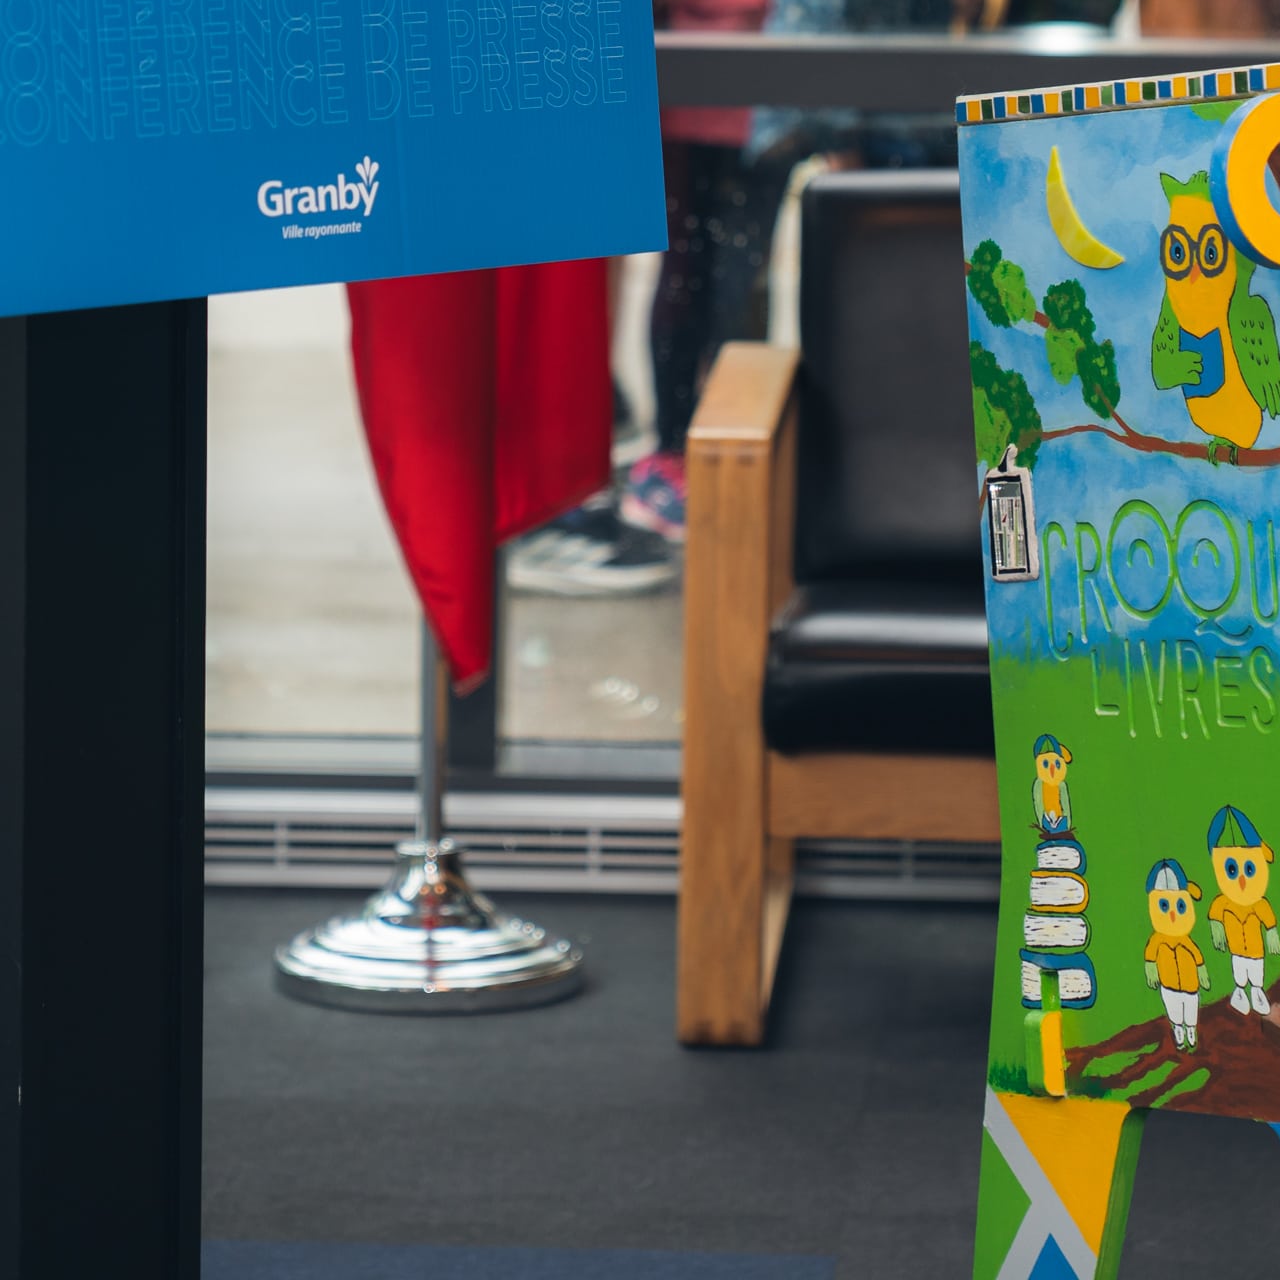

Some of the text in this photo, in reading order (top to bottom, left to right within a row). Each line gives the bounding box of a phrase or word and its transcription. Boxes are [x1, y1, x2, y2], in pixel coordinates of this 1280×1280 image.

[257, 168, 380, 220] Granby
[281, 219, 363, 241] Ville rayonnante
[1088, 638, 1277, 740] LIVRES
